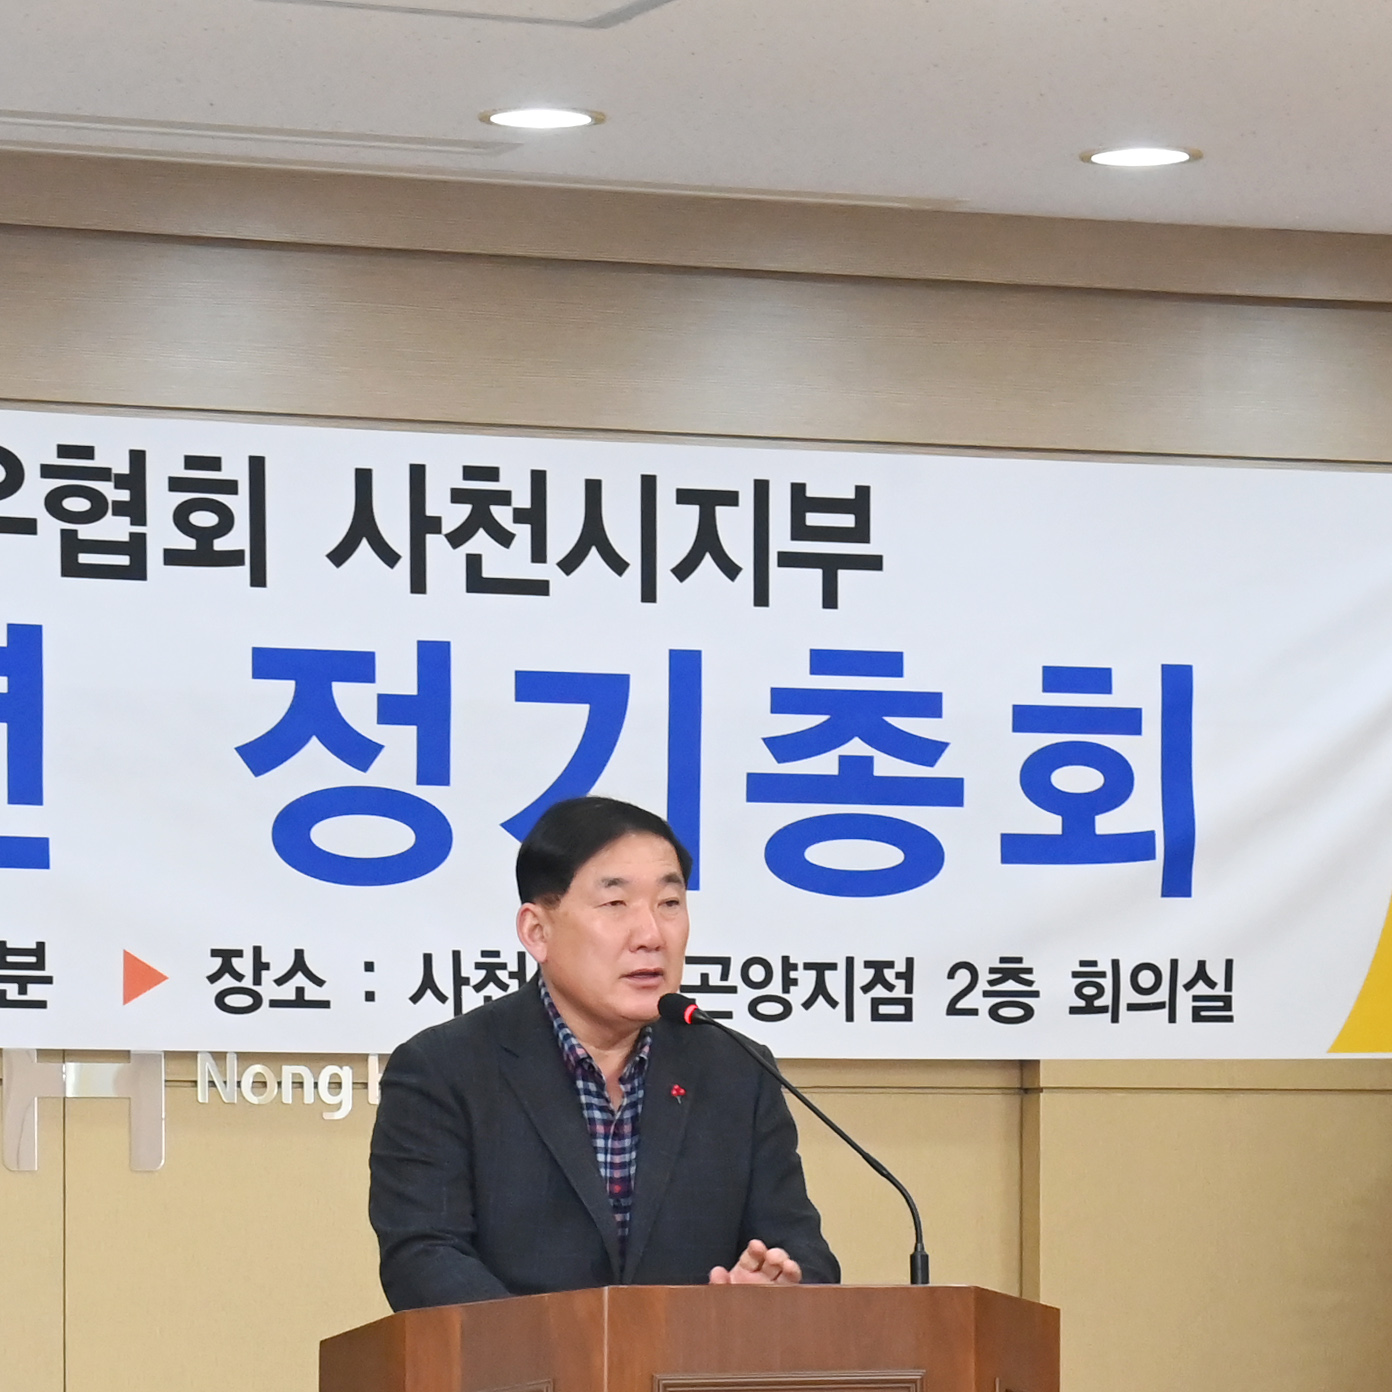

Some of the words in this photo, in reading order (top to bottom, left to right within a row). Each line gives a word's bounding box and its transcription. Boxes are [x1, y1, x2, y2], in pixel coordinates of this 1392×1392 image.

[326, 463, 884, 610] 사천시지부
[234, 639, 1196, 898] 정기총회
[206, 944, 332, 1015] 장소
[679, 955, 915, 1023] 곤양지점
[945, 956, 1040, 1025] 2층
[1068, 957, 1235, 1024] 회의실
[197, 1051, 353, 1120] Nong
